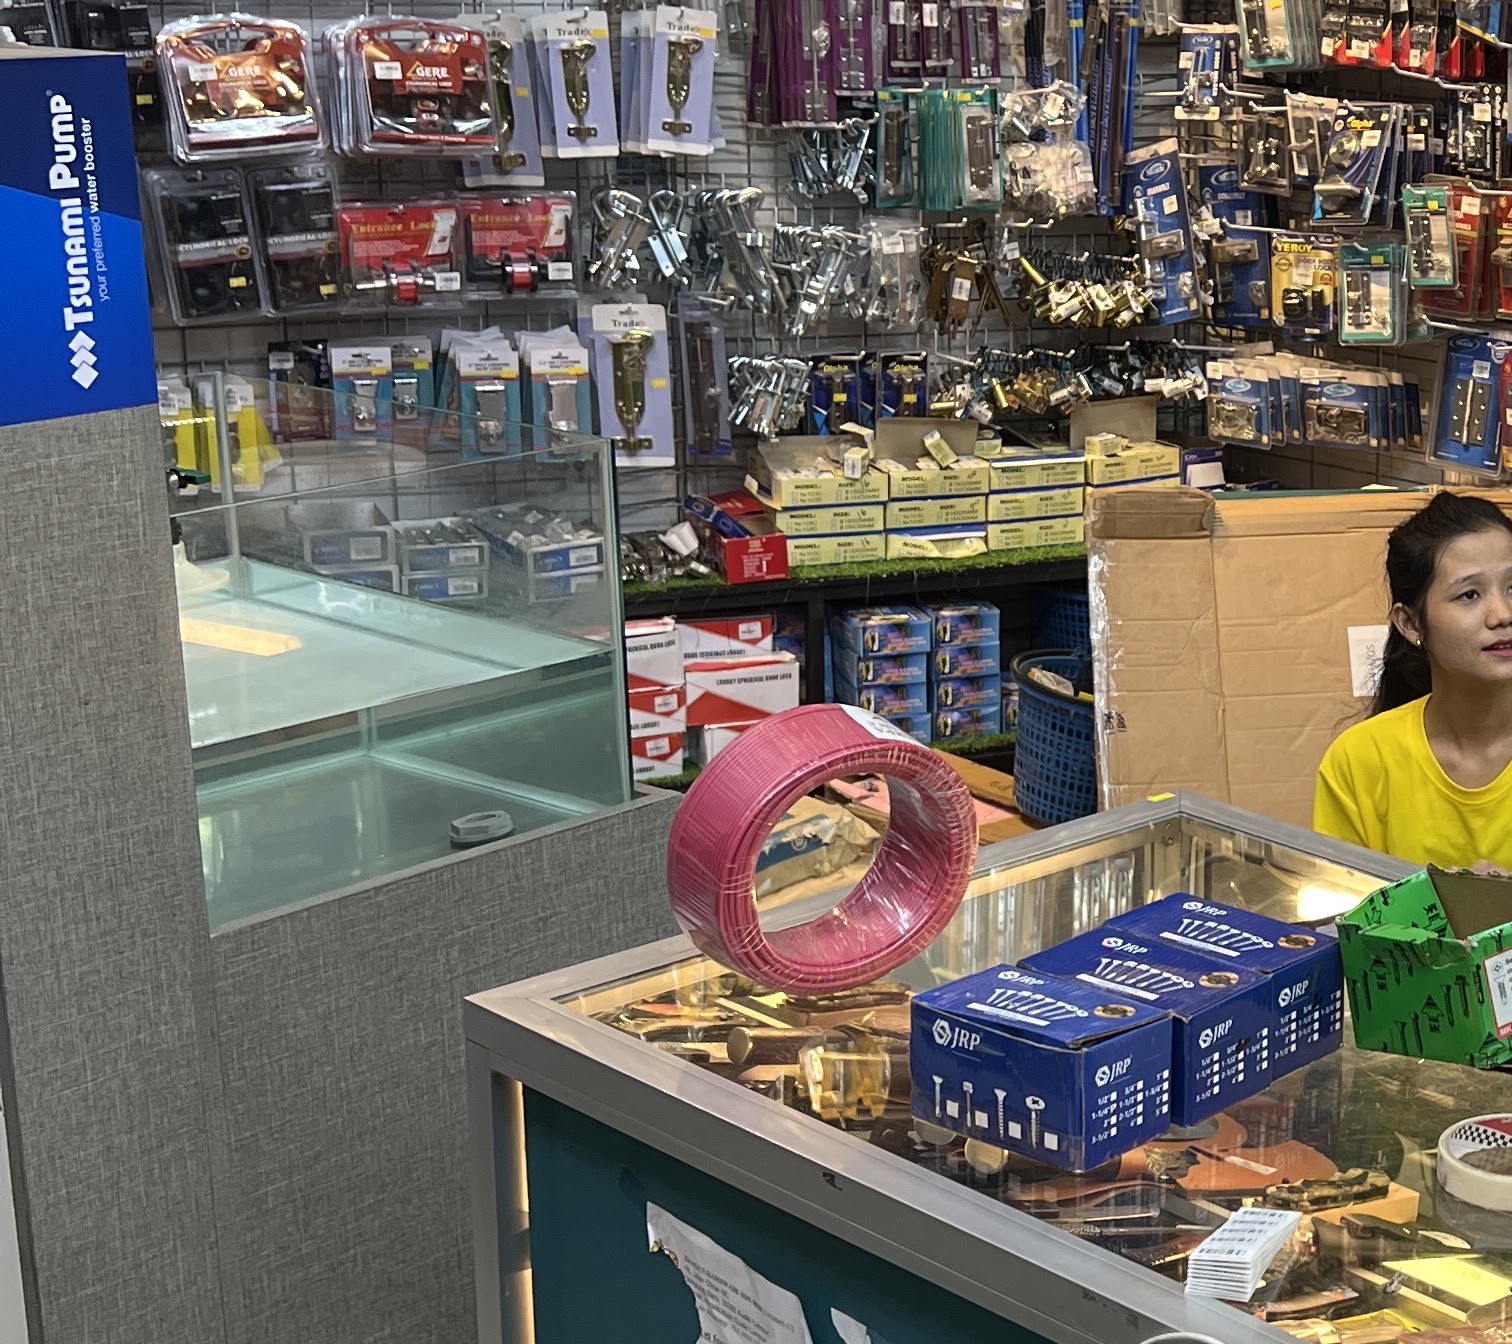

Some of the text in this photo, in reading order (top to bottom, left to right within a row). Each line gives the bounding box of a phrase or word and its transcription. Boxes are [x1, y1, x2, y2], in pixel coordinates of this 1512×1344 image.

[417, 65, 448, 78] GERE
[81, 117, 111, 302] your preferred water booster
[1276, 243, 1312, 253] YEROY
[1292, 979, 1309, 1001] JRP
[950, 1027, 981, 1052] JRP
[1213, 1019, 1232, 1043] JRP
[1112, 1057, 1131, 1083] JRP
